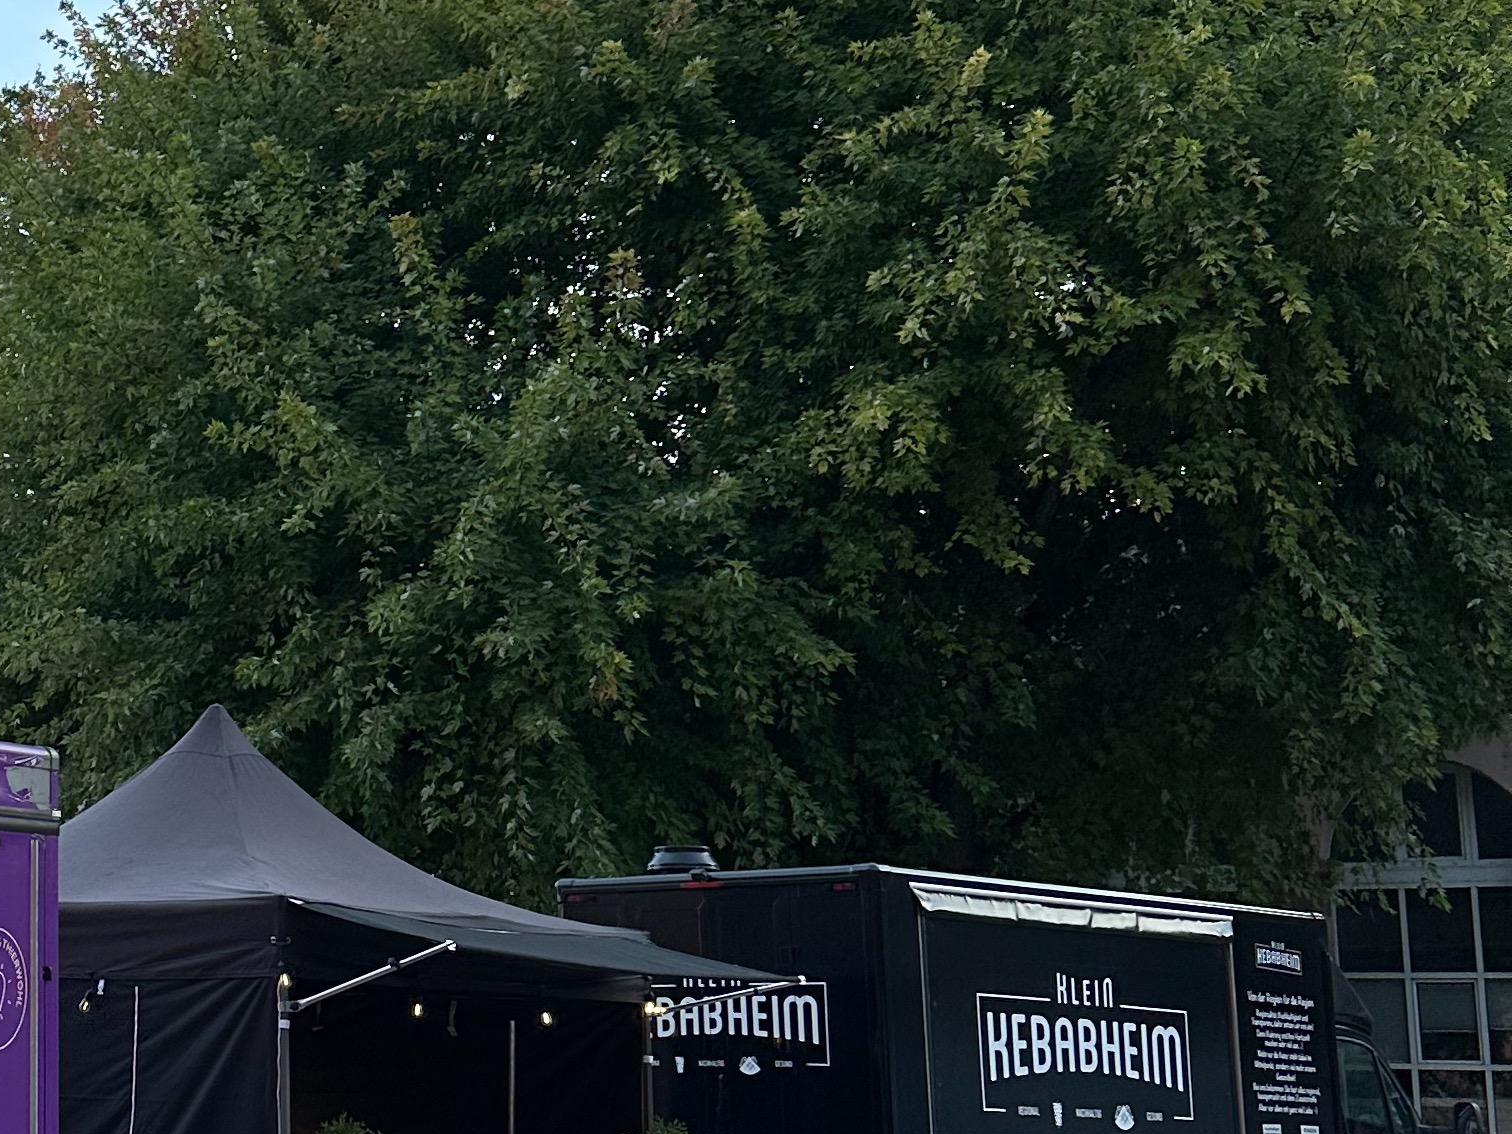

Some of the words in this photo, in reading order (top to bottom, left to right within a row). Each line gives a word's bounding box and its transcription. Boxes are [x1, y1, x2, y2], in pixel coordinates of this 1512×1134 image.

[1056, 972, 1114, 1008] KLEIN
[656, 995, 820, 1045] BABHEIM
[987, 1011, 1184, 1092] KEBABHEIM
